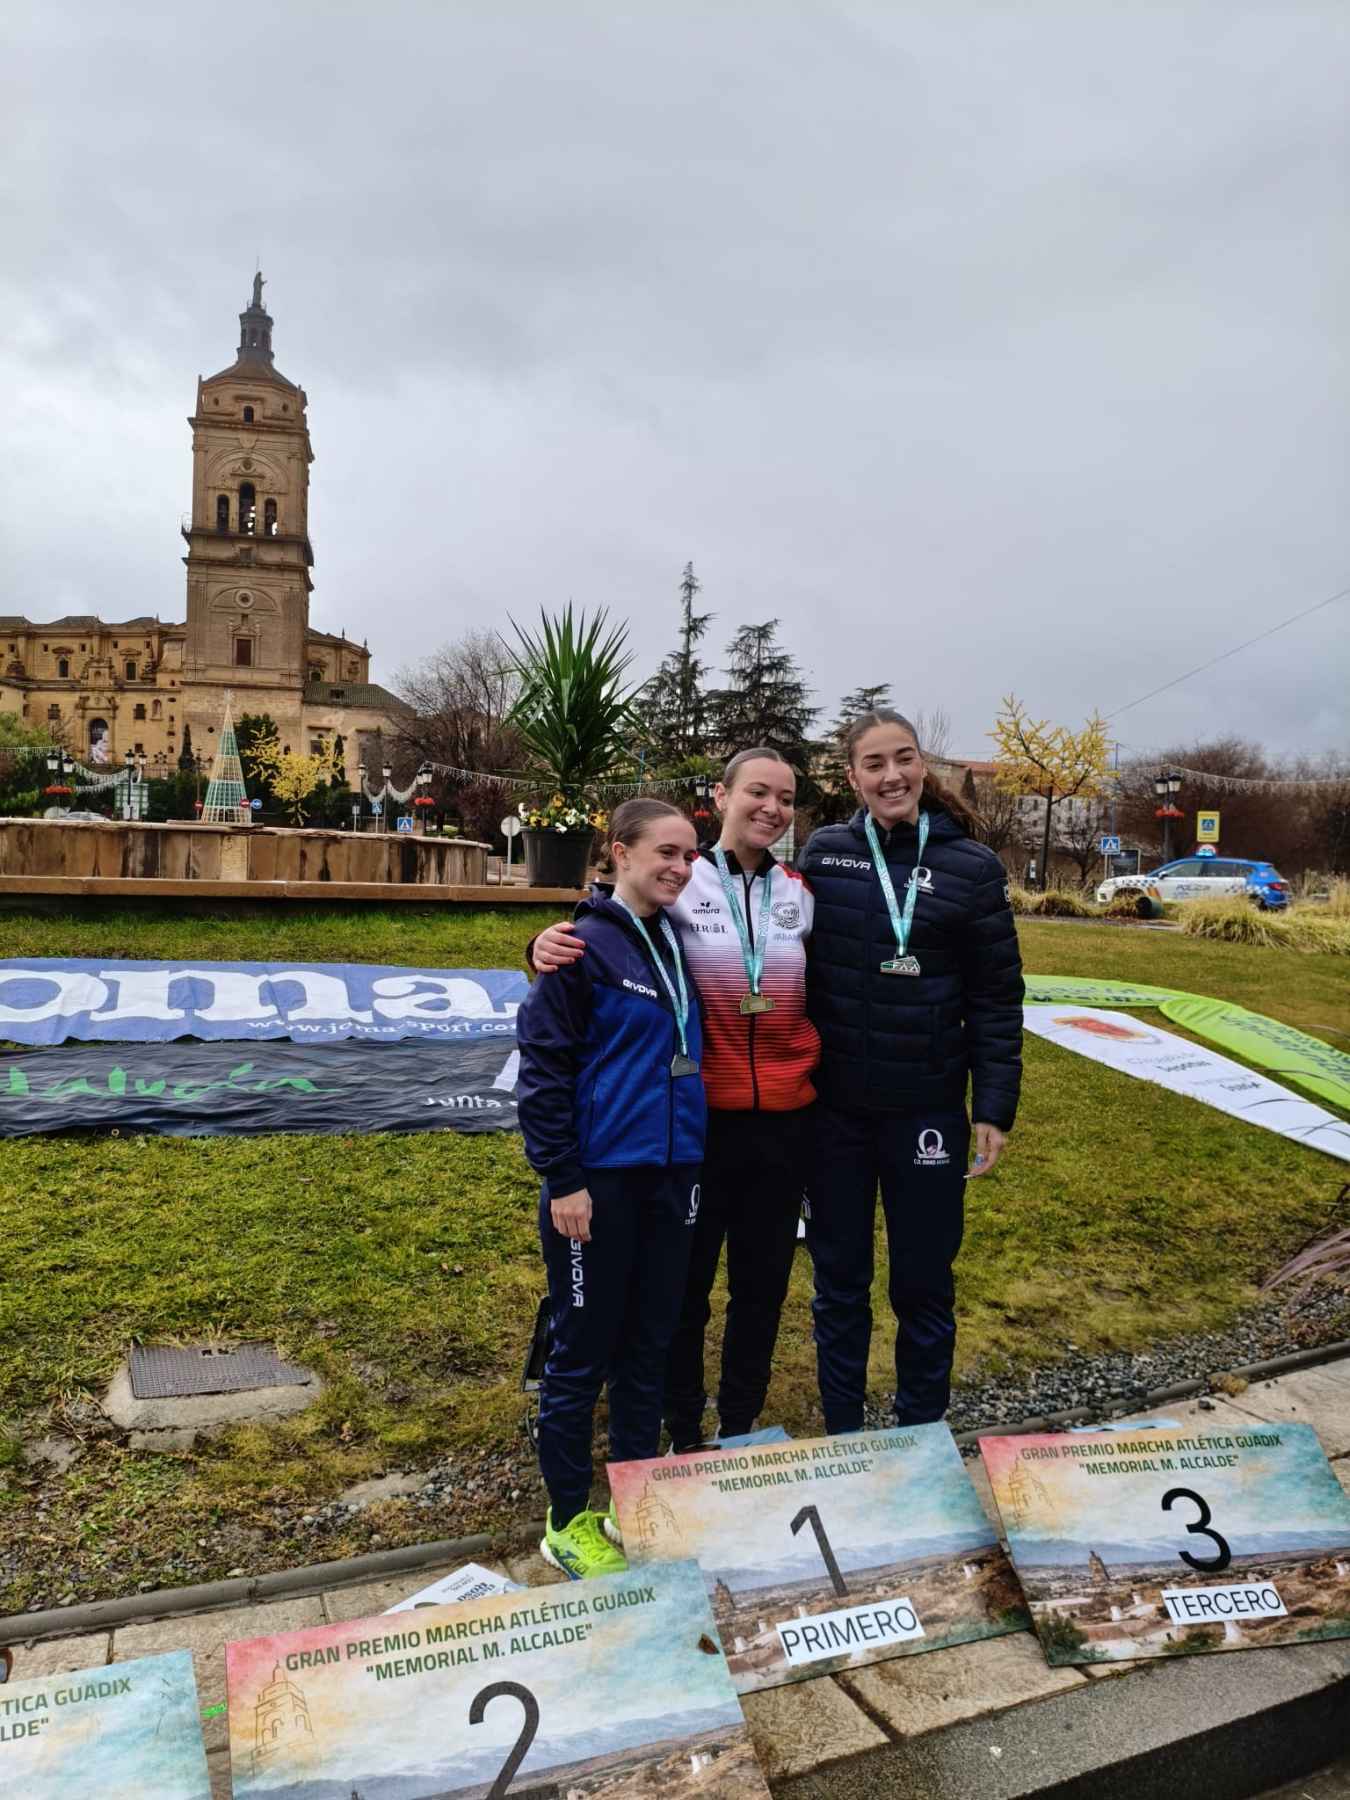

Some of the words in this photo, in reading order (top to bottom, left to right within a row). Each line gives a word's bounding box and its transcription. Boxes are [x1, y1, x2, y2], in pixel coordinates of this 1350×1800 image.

[821, 856, 872, 871] GIVOVA
[692, 907, 720, 915] amura
[622, 979, 658, 999] GIVOVA
[570, 1237, 585, 1308] GIVOVA
[652, 1463, 692, 1481] GRAN
[695, 1455, 749, 1475] PREMIO
[752, 1448, 809, 1468] MARCHA
[812, 1440, 870, 1459] ATLÉTICA
[872, 1435, 918, 1453] GUADIX
[1021, 1447, 1059, 1461] GRAN
[1061, 1443, 1114, 1458] PREMIO
[1116, 1440, 1174, 1455] MARCHA
[1176, 1434, 1234, 1450] ATLÉTICA
[1235, 1434, 1283, 1448] GUADIX
[1079, 1457, 1159, 1475] "MEMORIAL
[1160, 1458, 1178, 1472] M.
[1180, 1455, 1239, 1470] ALCALDE"
[712, 1470, 793, 1493] "MEMORIAL
[795, 1468, 813, 1482] M.
[815, 1459, 874, 1480] ALCALDE"
[1161, 1488, 1232, 1572] 3
[790, 1505, 850, 1598] 1
[1166, 1589, 1281, 1618] TERCERO
[286, 1649, 340, 1671] GRAN
[346, 1631, 421, 1658] PREMIO
[426, 1615, 506, 1643] MARCHA
[510, 1601, 589, 1629] ATLÉTICA
[593, 1587, 656, 1612] GUADIX
[781, 1606, 918, 1657] PRIMERO
[366, 1647, 479, 1681] "MEMORIAL
[483, 1641, 506, 1659] M.
[510, 1623, 593, 1654] ALCALDE"
[54, 1677, 132, 1706] GUADIX
[469, 1681, 558, 1800] 2
